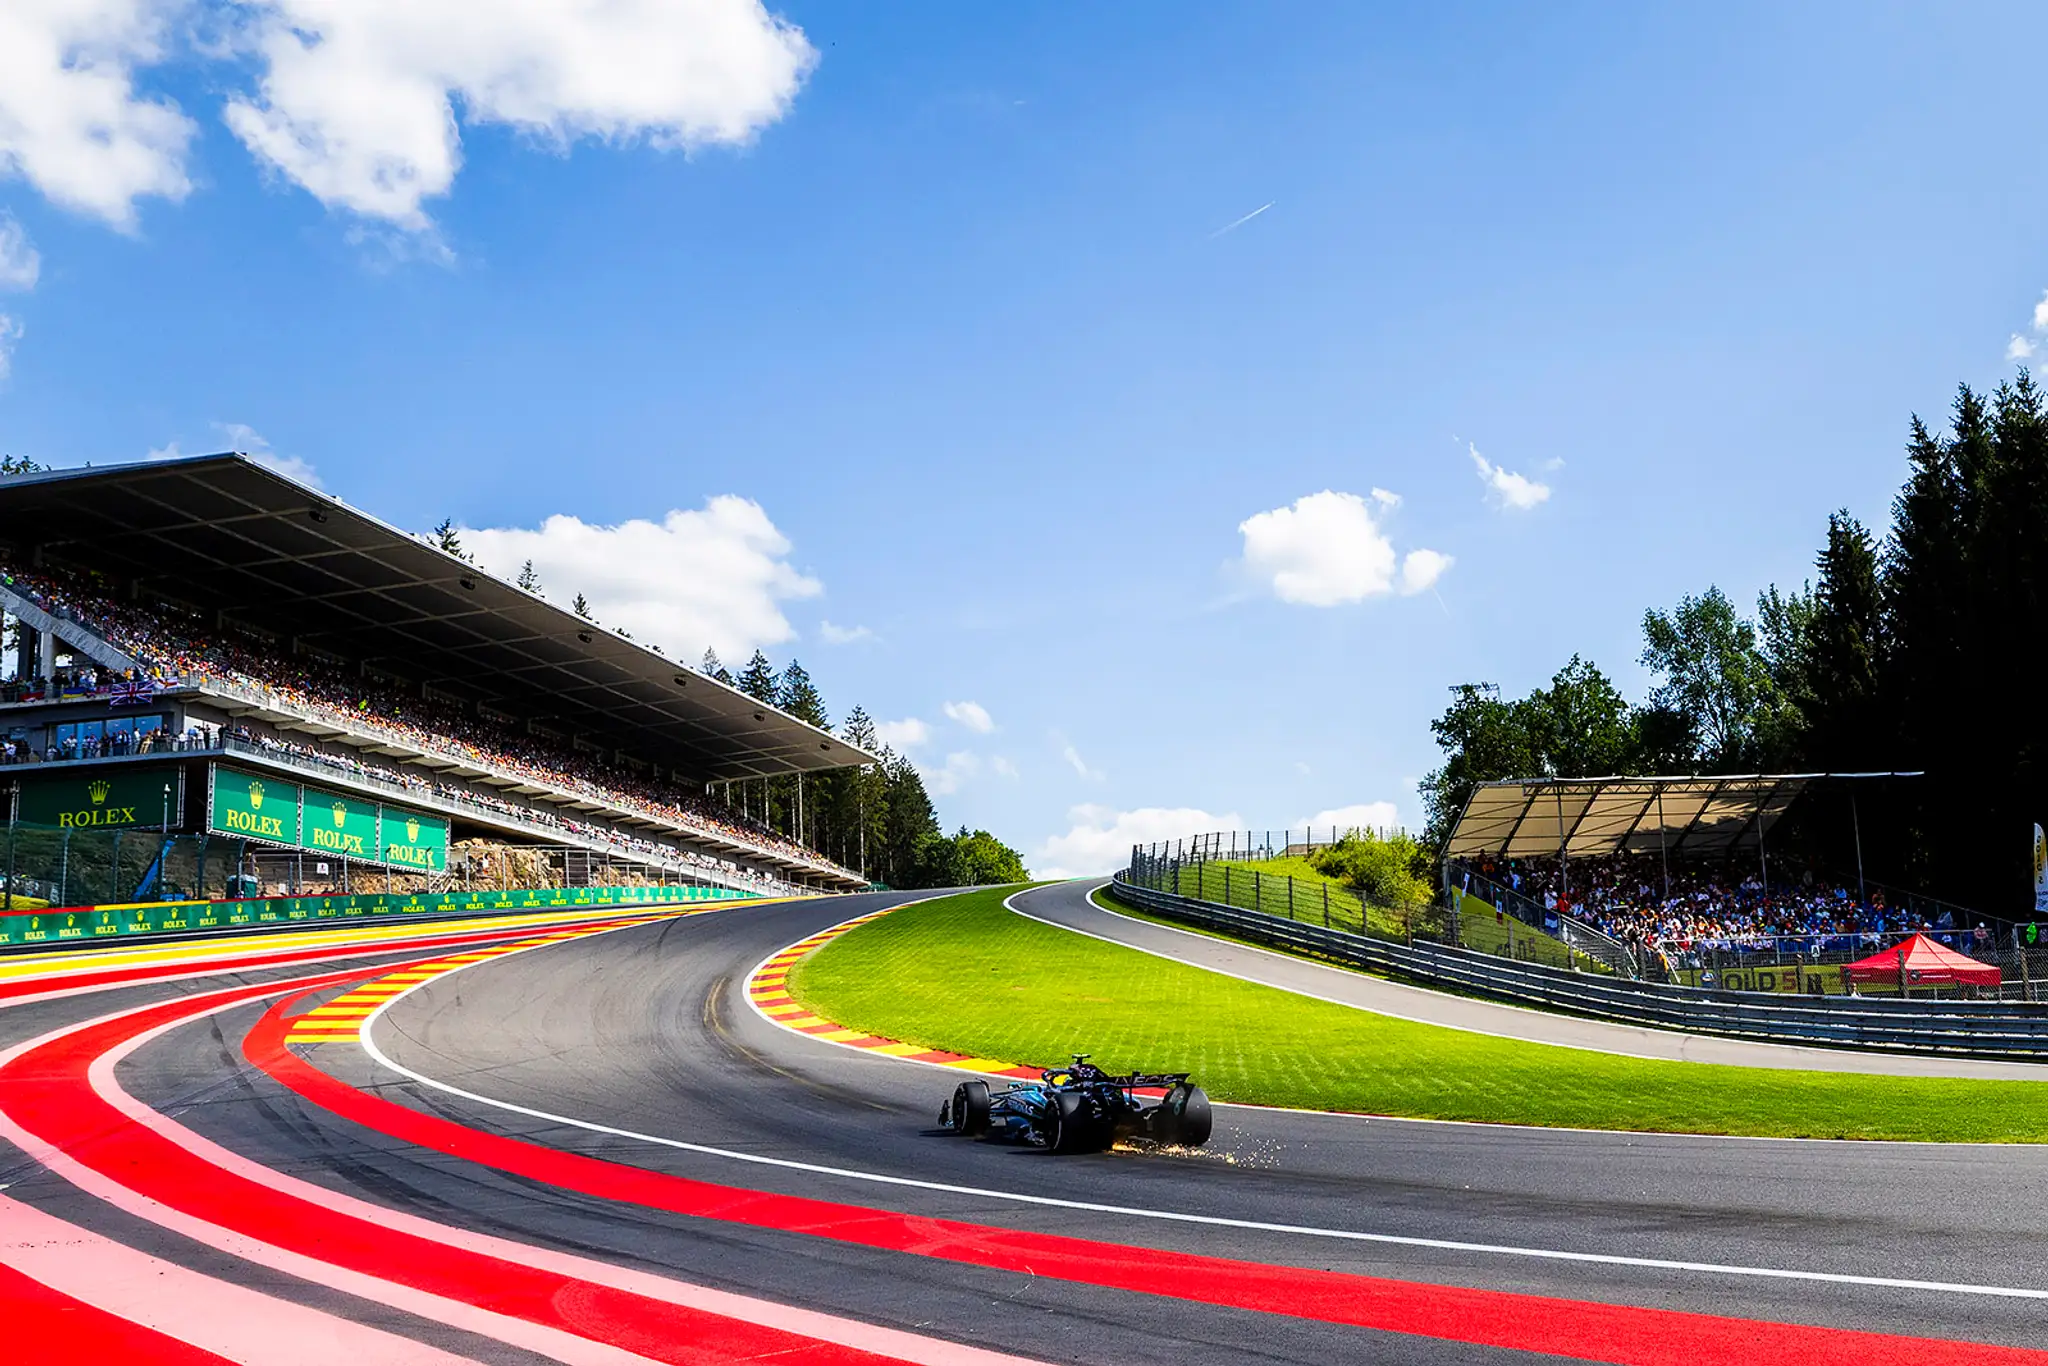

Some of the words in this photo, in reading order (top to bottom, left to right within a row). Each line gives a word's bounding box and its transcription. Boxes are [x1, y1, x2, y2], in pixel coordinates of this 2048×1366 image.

[59, 807, 136, 828] ROLEX
[227, 809, 283, 837] ROLEX
[313, 828, 364, 854] ROLEX
[389, 843, 435, 867] ROLEX
[230, 915, 249, 923] ROLEX
[260, 912, 277, 920] ROLEX
[163, 920, 186, 929] ROLEX
[200, 917, 217, 926] ROLEX
[95, 925, 117, 934] ROLEX
[129, 923, 151, 931] ROLEX
[25, 931, 46, 940] ROLEX
[59, 928, 81, 937] ROLEX
[1722, 972, 1777, 992] OLD
